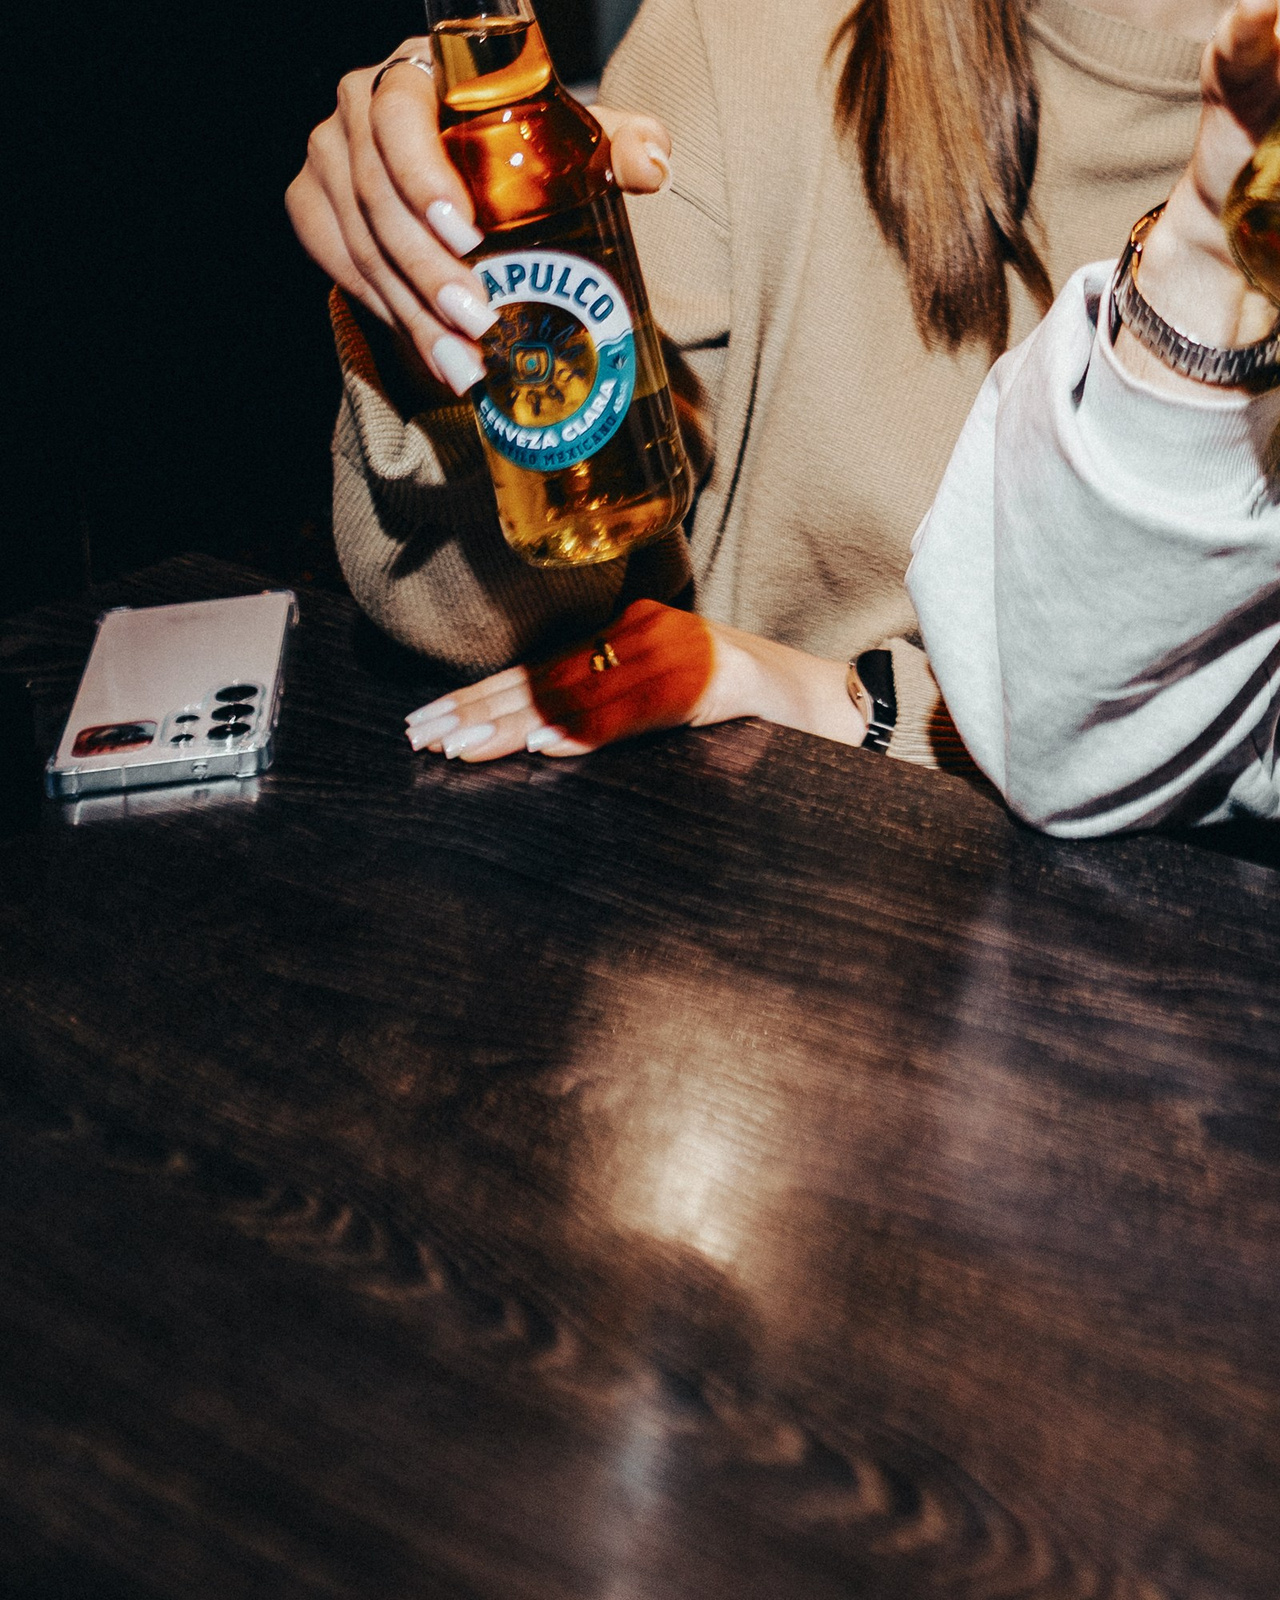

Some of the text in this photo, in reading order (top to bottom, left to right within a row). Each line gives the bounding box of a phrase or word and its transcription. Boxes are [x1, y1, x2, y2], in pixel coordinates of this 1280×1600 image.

[480, 263, 615, 324] APULCO
[480, 399, 560, 450] CERVEZA
[562, 376, 617, 442] CLARA
[544, 414, 617, 466] MEXICANO
